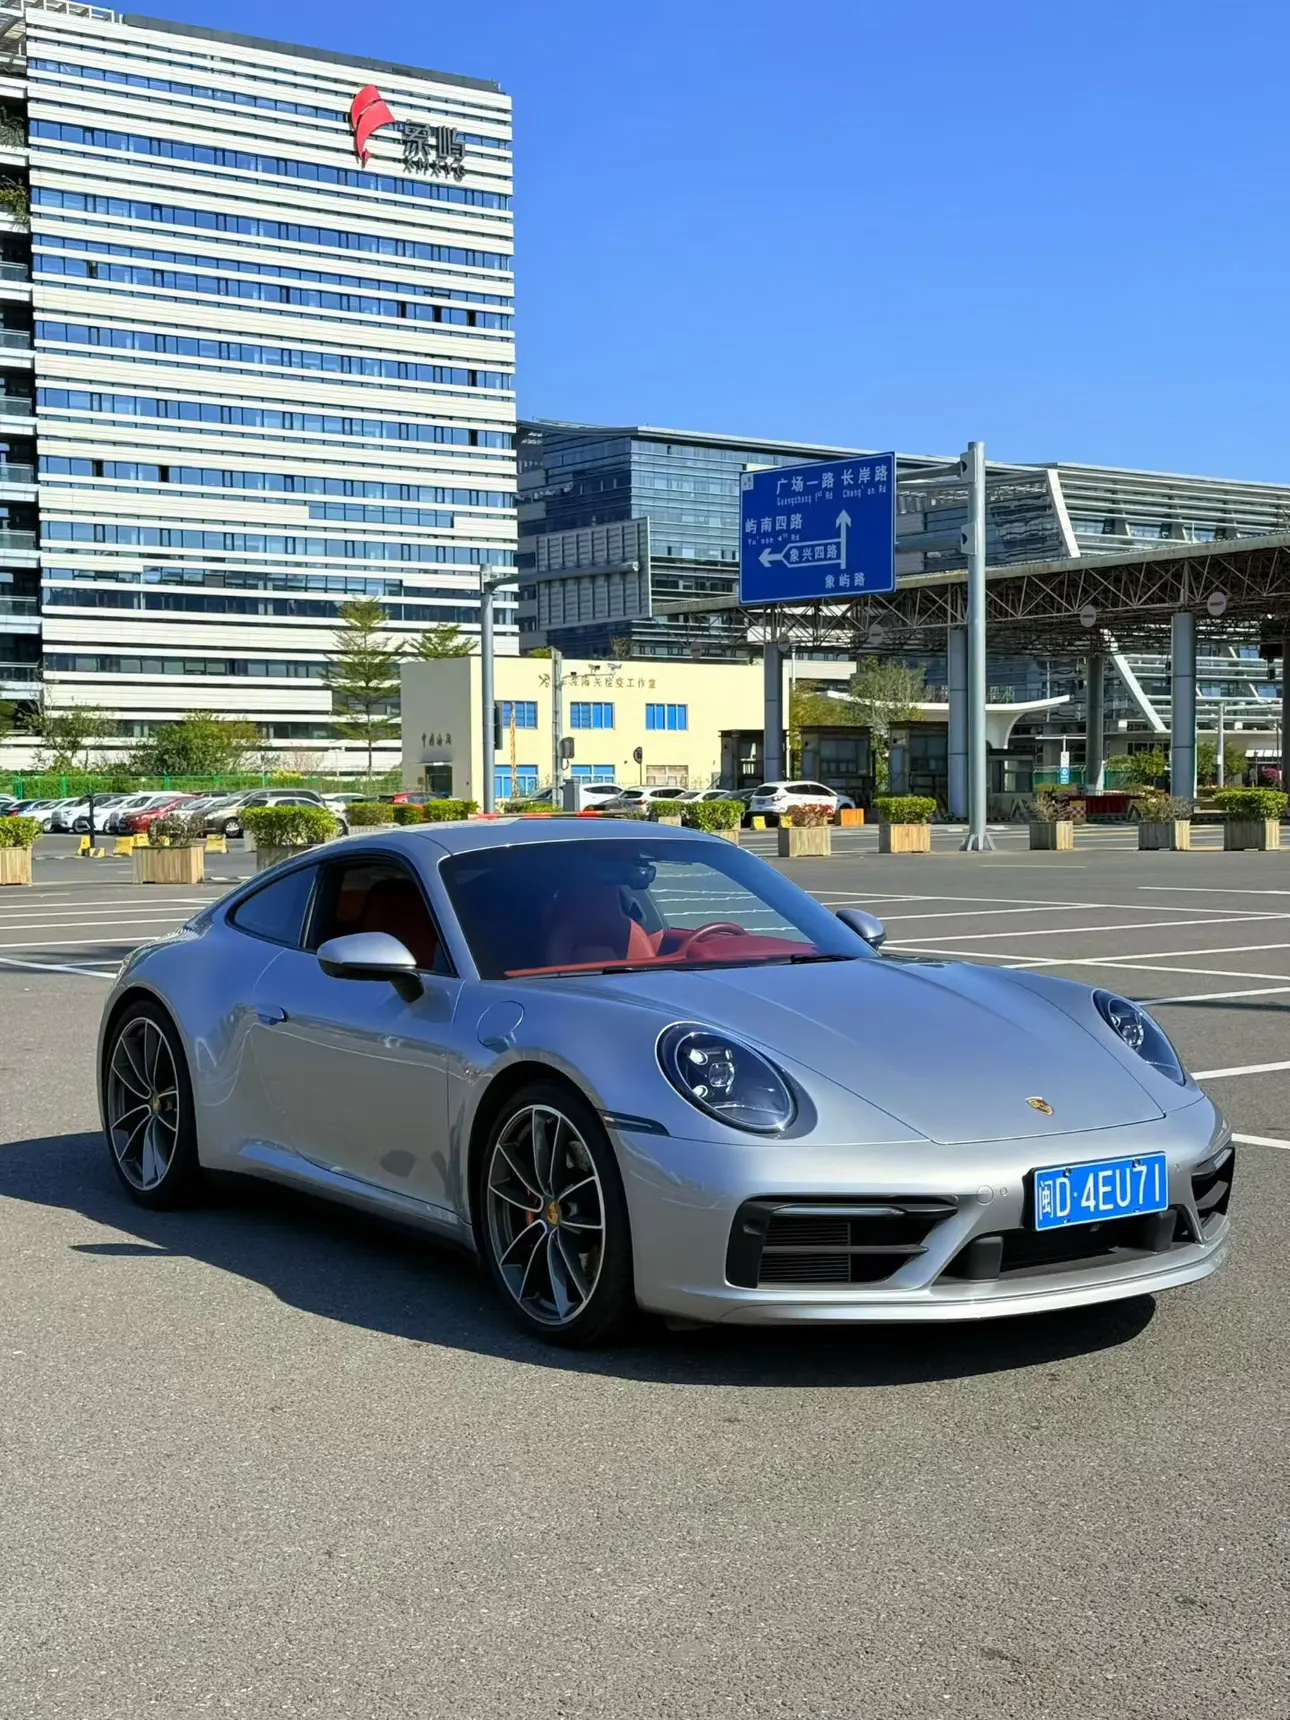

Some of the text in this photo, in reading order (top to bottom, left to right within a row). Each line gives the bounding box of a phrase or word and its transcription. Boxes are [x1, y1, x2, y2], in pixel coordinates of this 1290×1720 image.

[776, 472, 835, 494] 广场一路
[841, 465, 888, 486] 长岸路
[745, 513, 803, 534] 屿南四路
[789, 544, 838, 562] 象兴四路
[825, 572, 866, 589] 象屿路
